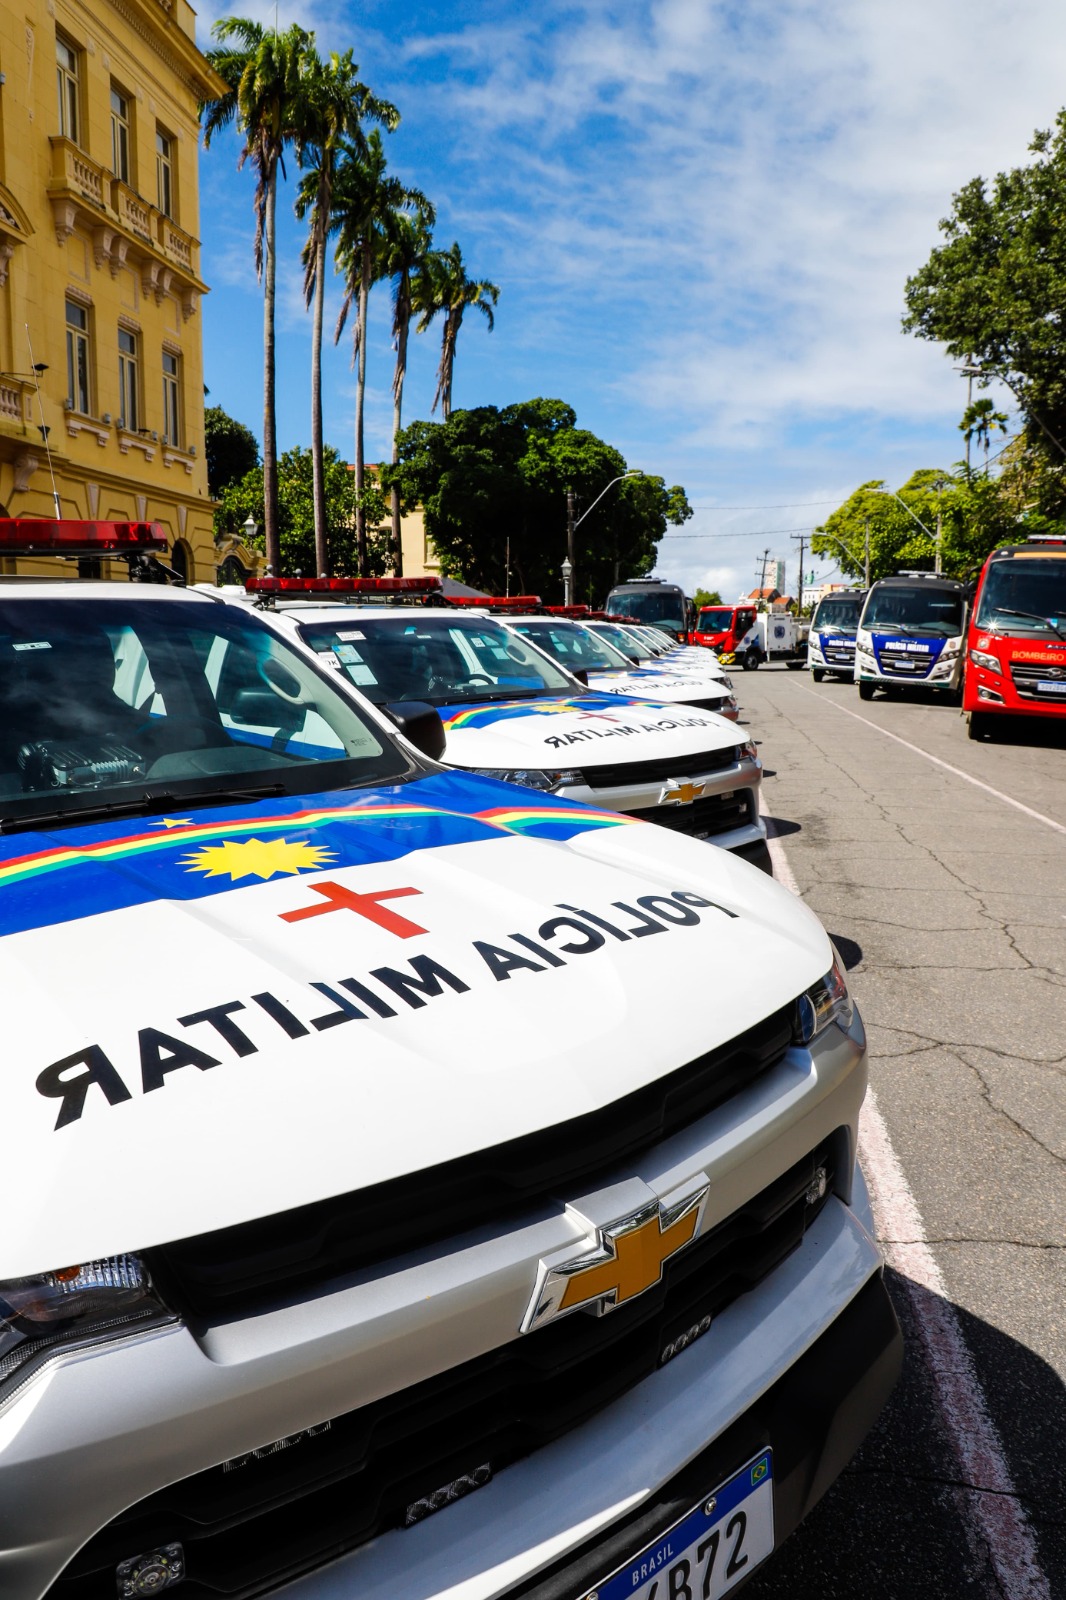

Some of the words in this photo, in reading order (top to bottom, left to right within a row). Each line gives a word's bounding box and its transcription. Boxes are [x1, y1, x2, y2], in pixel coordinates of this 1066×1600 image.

[1012, 651, 1064, 661] BOMBEIRO
[632, 1543, 674, 1586] BRASIL
[648, 1511, 748, 1600] B72
